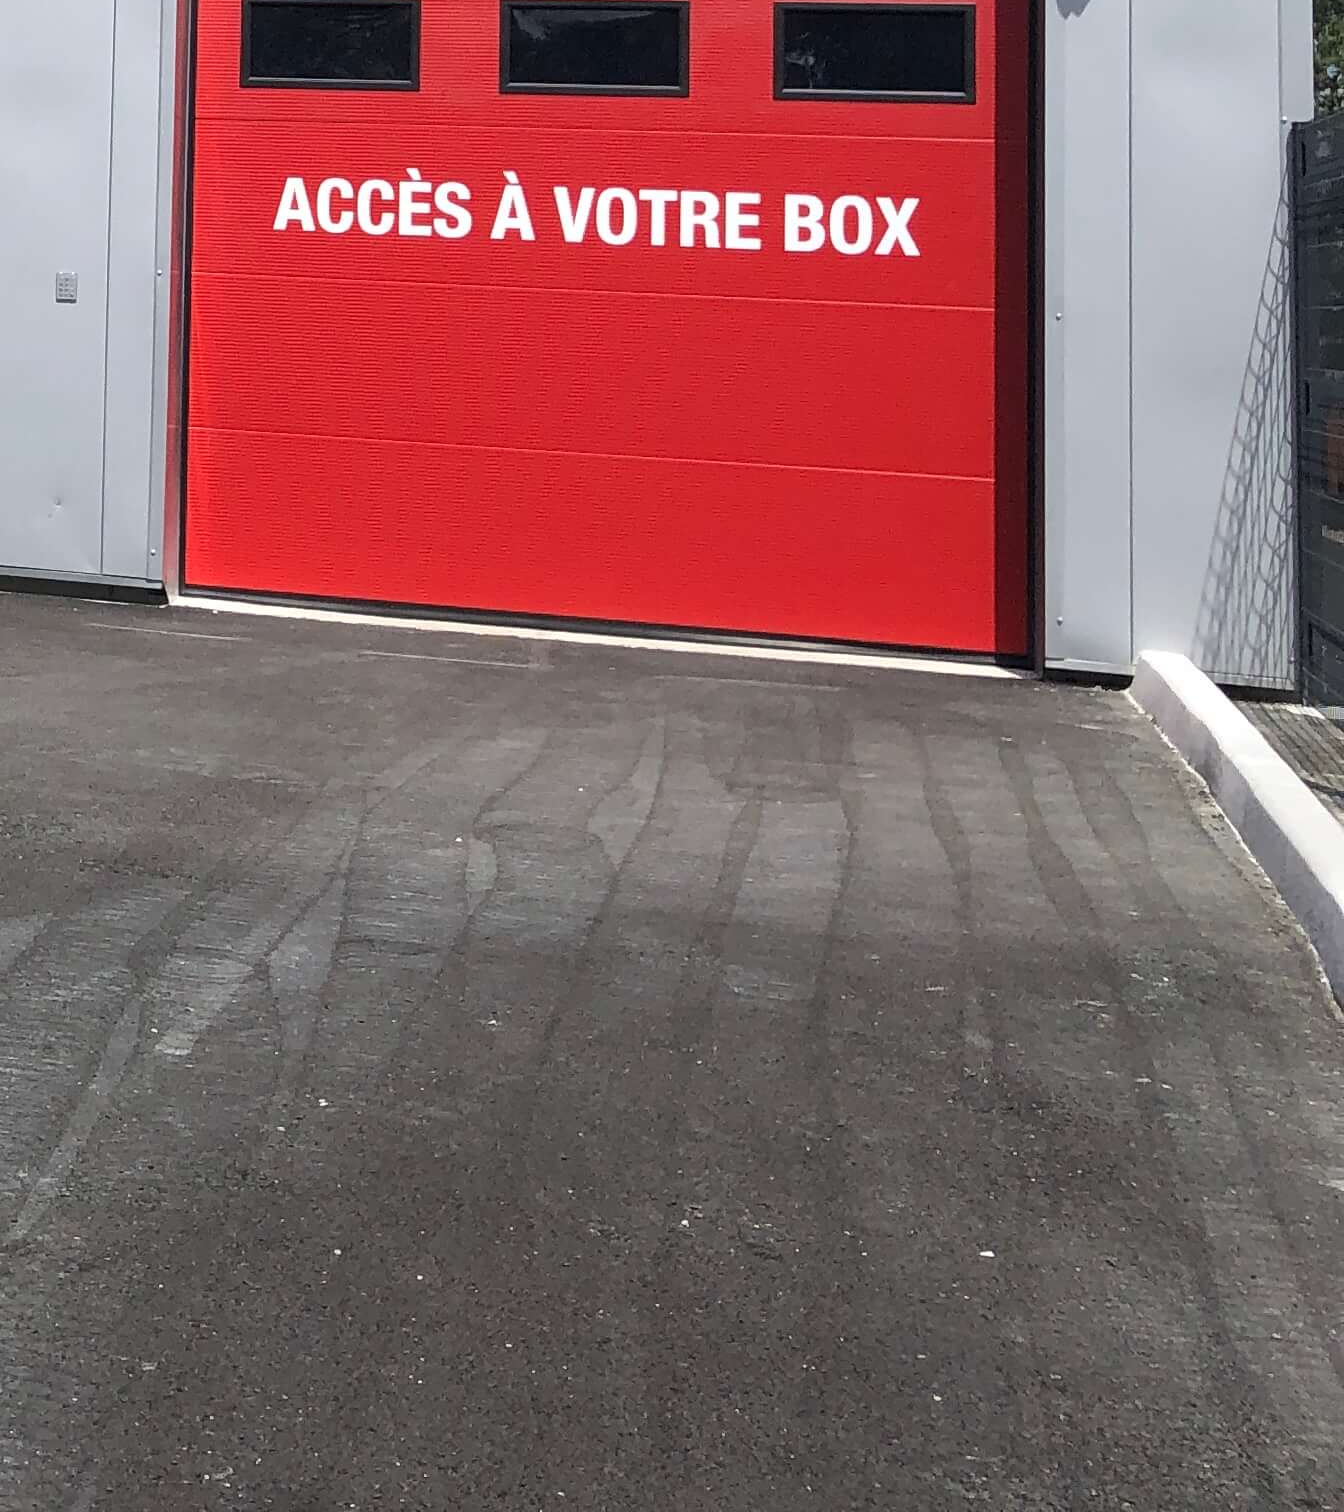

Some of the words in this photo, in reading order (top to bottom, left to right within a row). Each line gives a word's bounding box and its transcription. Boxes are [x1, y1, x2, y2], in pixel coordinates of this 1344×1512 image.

[272, 167, 472, 239] ACCÈS
[489, 170, 536, 242] À
[553, 184, 762, 251] VOTRE
[783, 193, 921, 257] BOX
